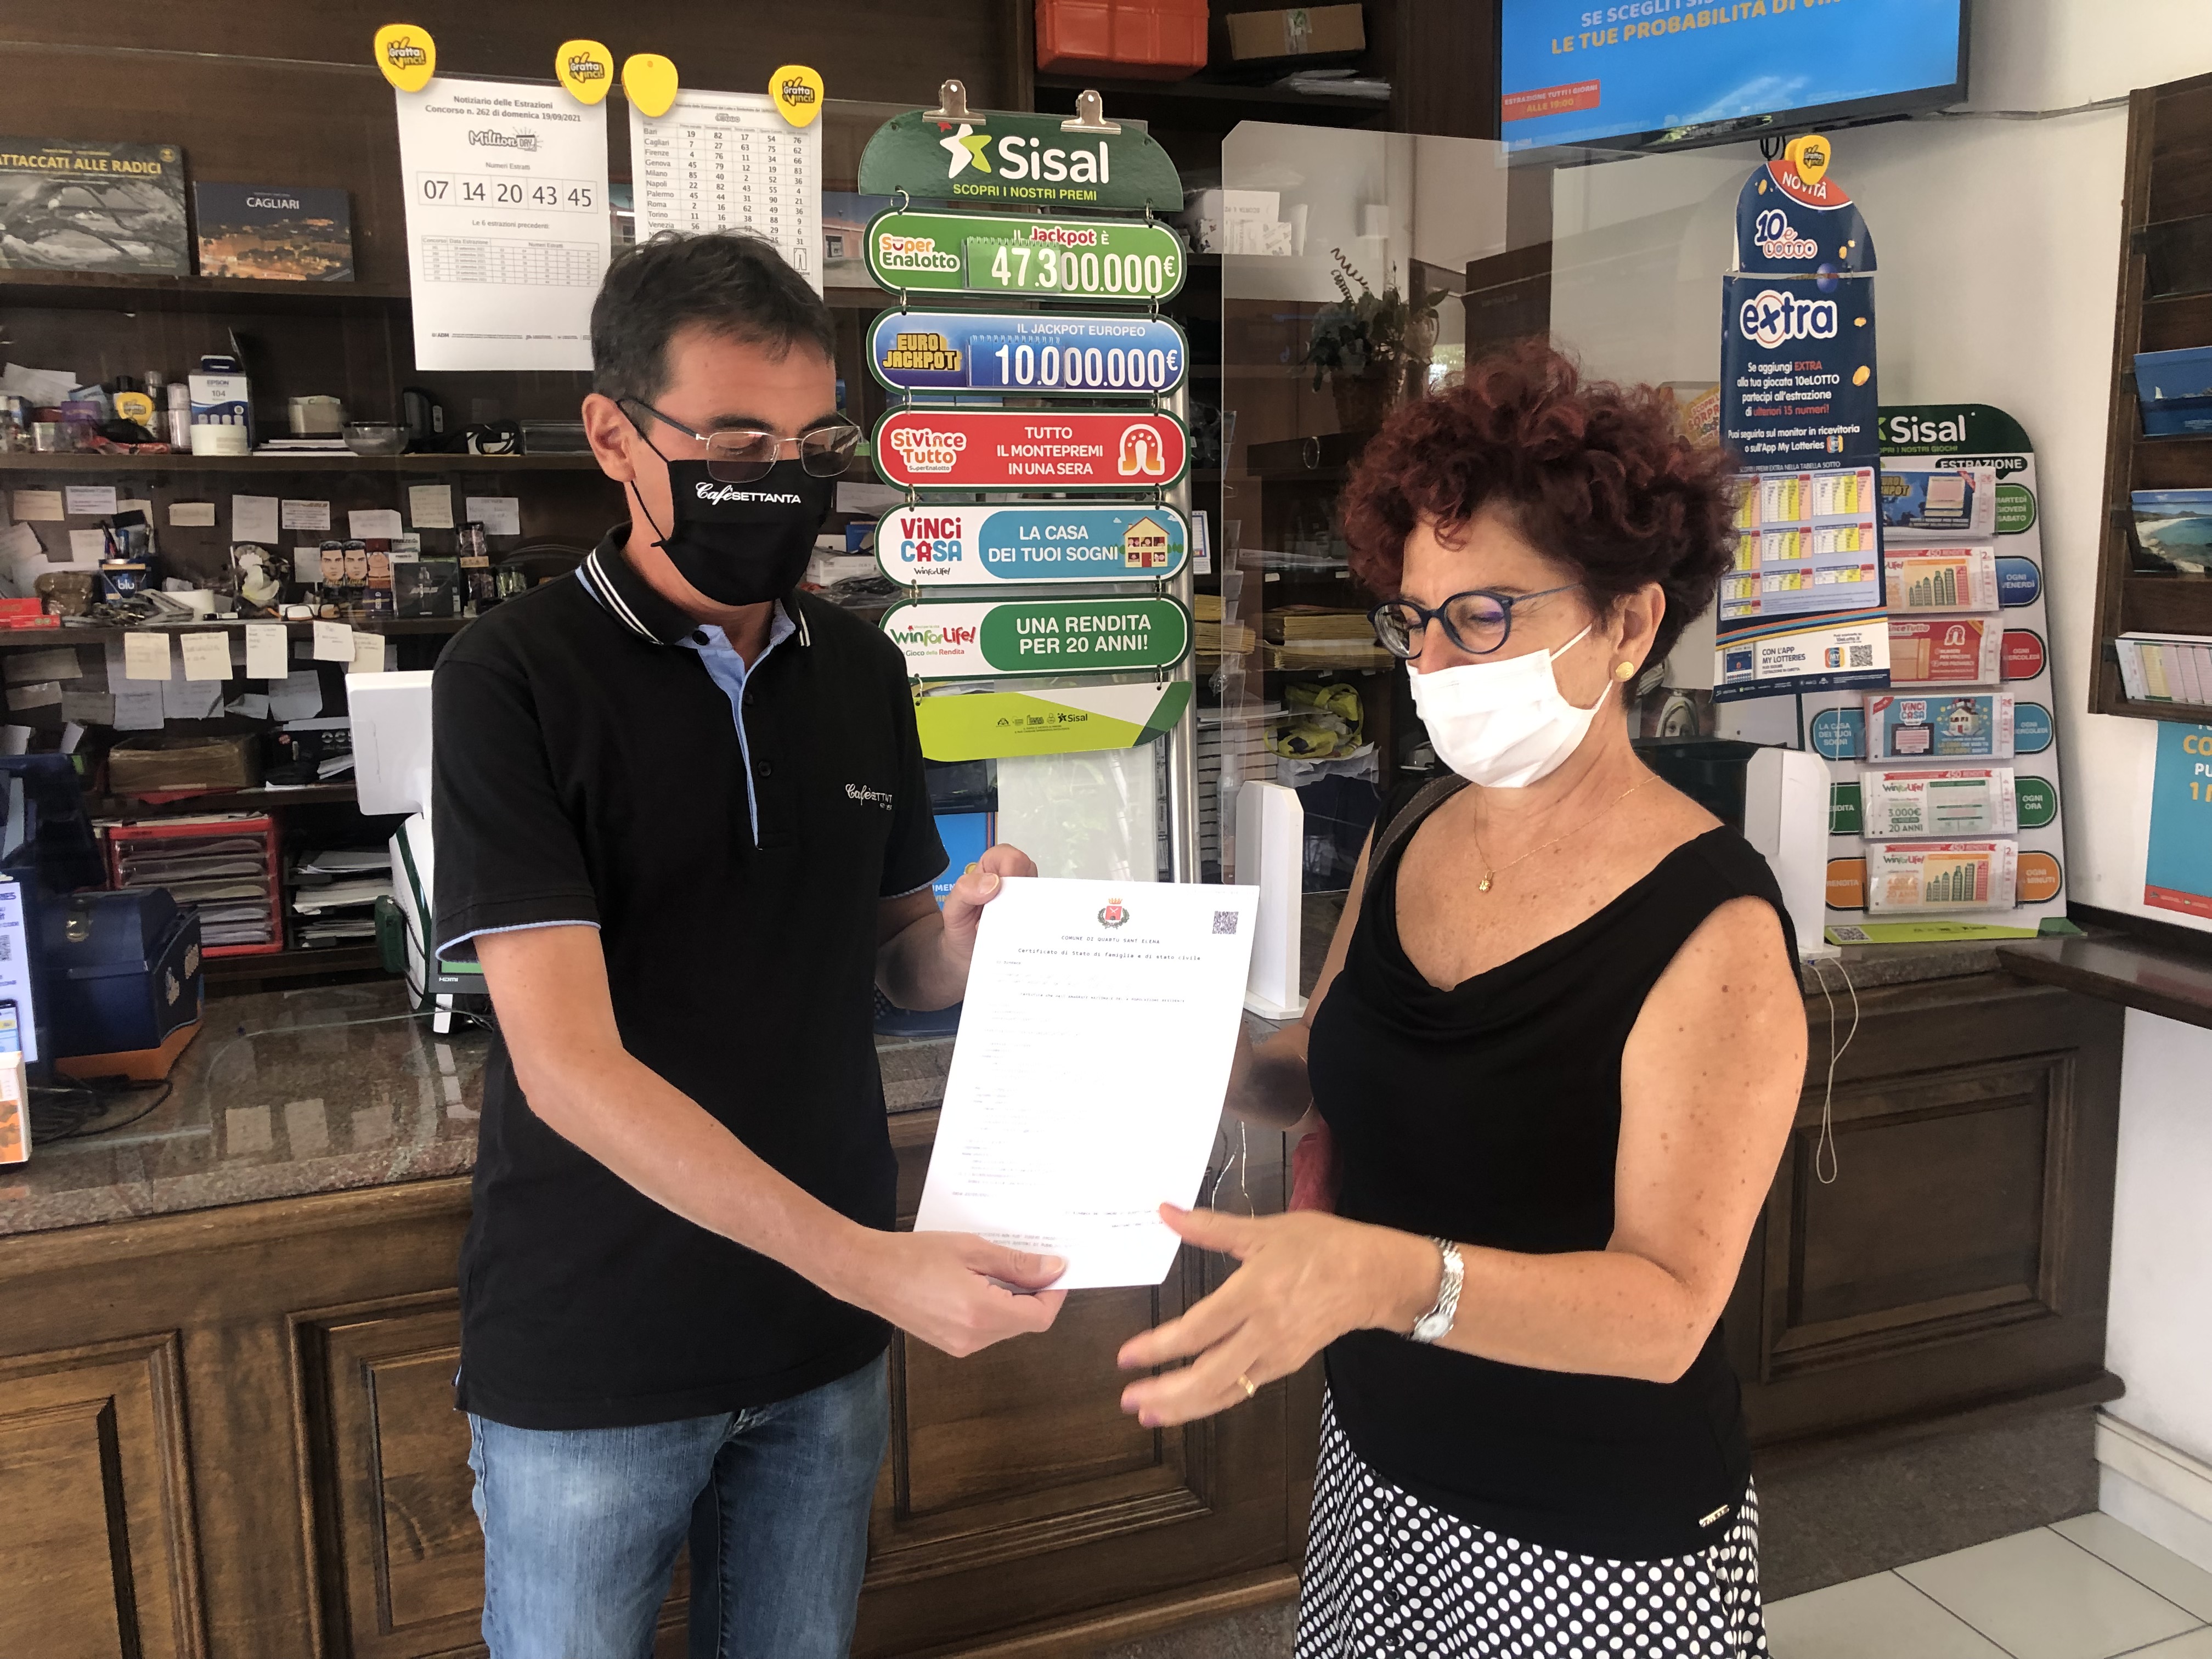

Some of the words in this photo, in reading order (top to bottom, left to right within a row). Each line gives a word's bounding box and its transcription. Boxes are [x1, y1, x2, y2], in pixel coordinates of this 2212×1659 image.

[1581, 10, 1602, 27] SE
[1607, 0, 1671, 23] SCEGLI
[1552, 36, 1574, 54] LE
[1579, 28, 1618, 49] TUE
[389, 48, 420, 57] Gratta
[571, 62, 599, 71] Gratta
[783, 85, 810, 95] Gratta
[1505, 93, 1545, 105] ESTRAZIONE
[1548, 90, 1567, 98] TUTTI
[1573, 84, 1598, 94] GIORNI
[454, 95, 492, 105] Notiziario
[493, 98, 512, 107] delle
[514, 100, 553, 109] Estrazioni
[1527, 104, 1547, 113] ALLE
[425, 105, 465, 114] Concorso
[501, 111, 539, 119] domenica
[542, 112, 582, 122] 19/09/2021
[469, 129, 517, 147] Million
[644, 138, 669, 146] Cagliari
[75, 157, 108, 171] ALLE
[111, 160, 162, 174] RADICI
[998, 136, 1109, 184] Sisal
[953, 184, 1000, 196] SCOPRI
[1003, 187, 1007, 196] I
[1011, 187, 1056, 199] NOSTRI
[1059, 189, 1097, 201] PREMI
[1782, 171, 1826, 199] NOVITÀ
[424, 180, 449, 200] 07
[462, 182, 486, 201] 14
[497, 183, 523, 204] 20
[532, 186, 557, 205] 43
[567, 188, 592, 207] 45
[246, 196, 301, 211] CAGLIARI
[1757, 213, 1784, 242] 10
[1029, 227, 1094, 246] Jackpot
[1101, 230, 1109, 245] È
[882, 238, 932, 254] Super
[1764, 241, 1816, 258] LOTTO
[883, 252, 957, 269] Enalotto
[992, 246, 1176, 293] 47.300.000€
[1742, 296, 1833, 335] extra
[1018, 324, 1028, 334] IL
[1031, 324, 1085, 336] JACKPOT
[1088, 325, 1146, 337] EUROPEO
[897, 334, 939, 351] EURO
[883, 351, 958, 370] JACKPOT
[995, 344, 1178, 388] 10.000.000€
[1748, 362, 1757, 373] Se
[1758, 362, 1793, 375] aggiungi
[1794, 360, 1822, 371] EXTRA
[1763, 377, 1793, 390] giocata
[1742, 391, 1773, 404] partecipi
[1745, 407, 1752, 417] di
[1784, 405, 1793, 415] 15
[1795, 403, 1830, 415] numeri!
[1024, 427, 1073, 439] TUTTO
[1765, 428, 1776, 437] sul
[1778, 427, 1807, 437] monitor
[1808, 426, 1816, 436] in
[1818, 424, 1860, 435] ricevitoria
[1890, 414, 1966, 444] Sisal
[996, 444, 1008, 457] IL
[1011, 445, 1103, 458] MONTEPREMI
[1778, 442, 1790, 453] My
[1791, 440, 1825, 451] Lotteries
[903, 448, 953, 464] Tutto
[1940, 459, 2023, 469] ESTRAZIONE
[1008, 463, 1023, 475] IN
[1025, 463, 1055, 475] UNA
[1057, 463, 1093, 476] SERA
[1019, 527, 1040, 541] LA
[1045, 525, 1088, 540] CASA
[900, 540, 962, 563] CASA
[988, 548, 1016, 563] DEI
[1023, 547, 1062, 562] TUOI
[1066, 546, 1118, 561] SOGNI
[117, 579, 135, 590] blu
[1016, 617, 1059, 635] UNA
[1065, 614, 1152, 633] RENDITA
[1019, 637, 1060, 656] PER
[1066, 636, 1090, 653] 20
[1094, 634, 1149, 652] ANNI!
[1762, 647, 1776, 656] CON
[1762, 656, 1772, 664] MY
[1773, 653, 1806, 663] LOTTERIES
[1068, 713, 1088, 723] Sisal
[1889, 825, 1900, 833] 20
[1901, 824, 1923, 832] ANNI
